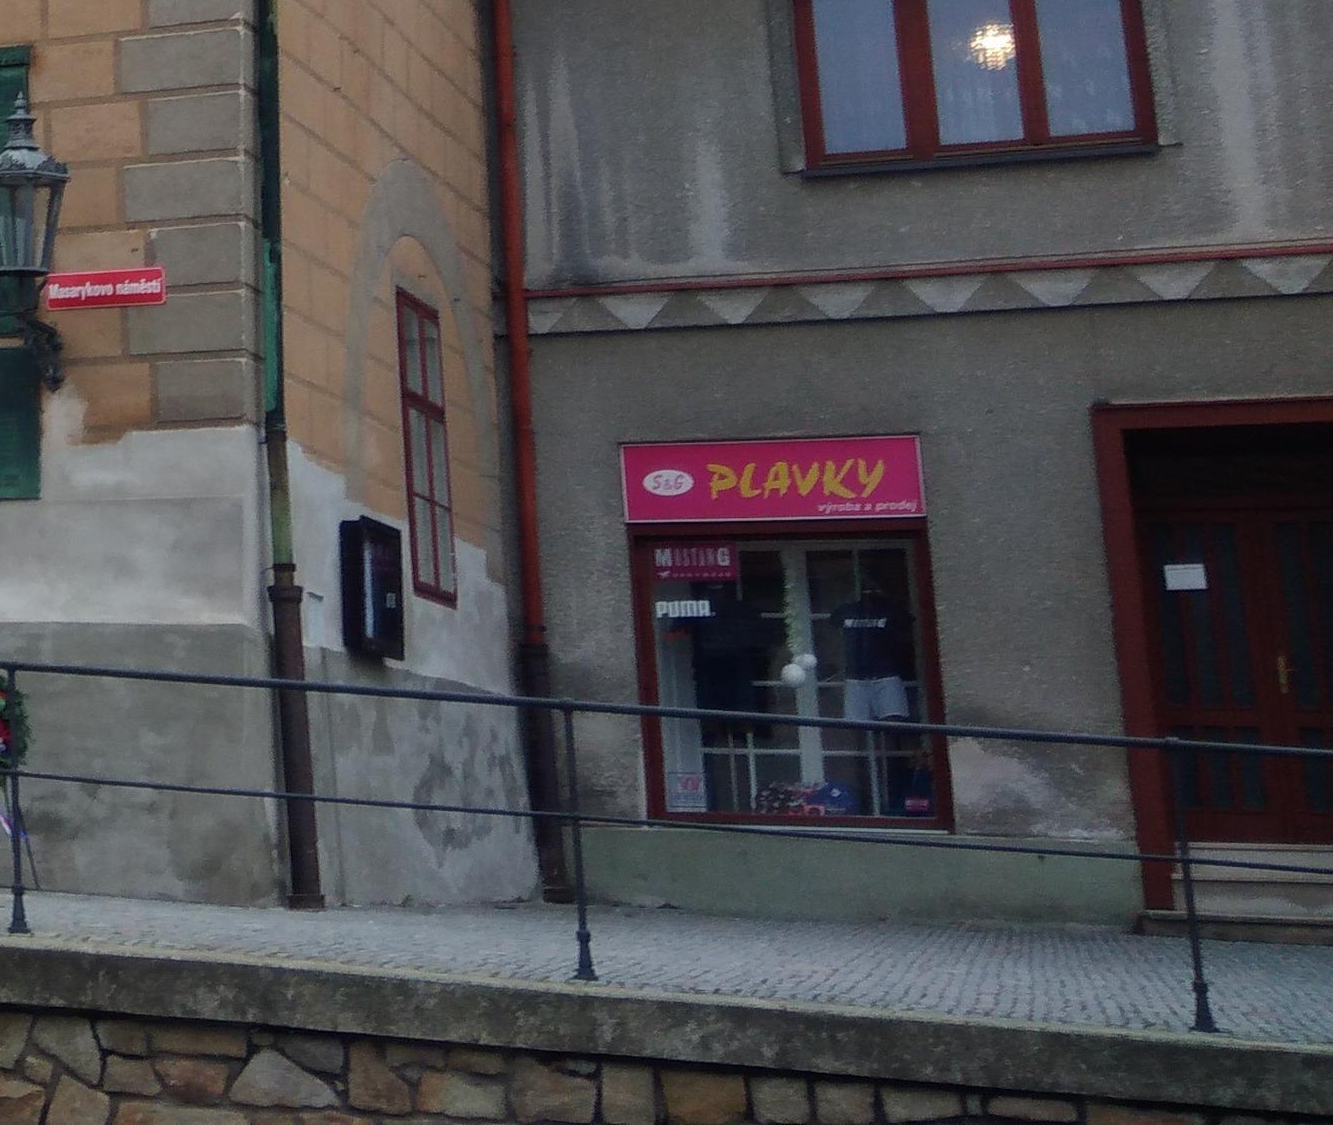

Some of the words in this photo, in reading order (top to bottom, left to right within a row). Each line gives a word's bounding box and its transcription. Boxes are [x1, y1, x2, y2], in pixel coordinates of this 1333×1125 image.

[48, 281, 113, 300] Masarykovo
[115, 278, 162, 295] náměstí
[706, 458, 885, 500] PLAVKY
[817, 501, 861, 514] výroba
[875, 499, 917, 513] prodej
